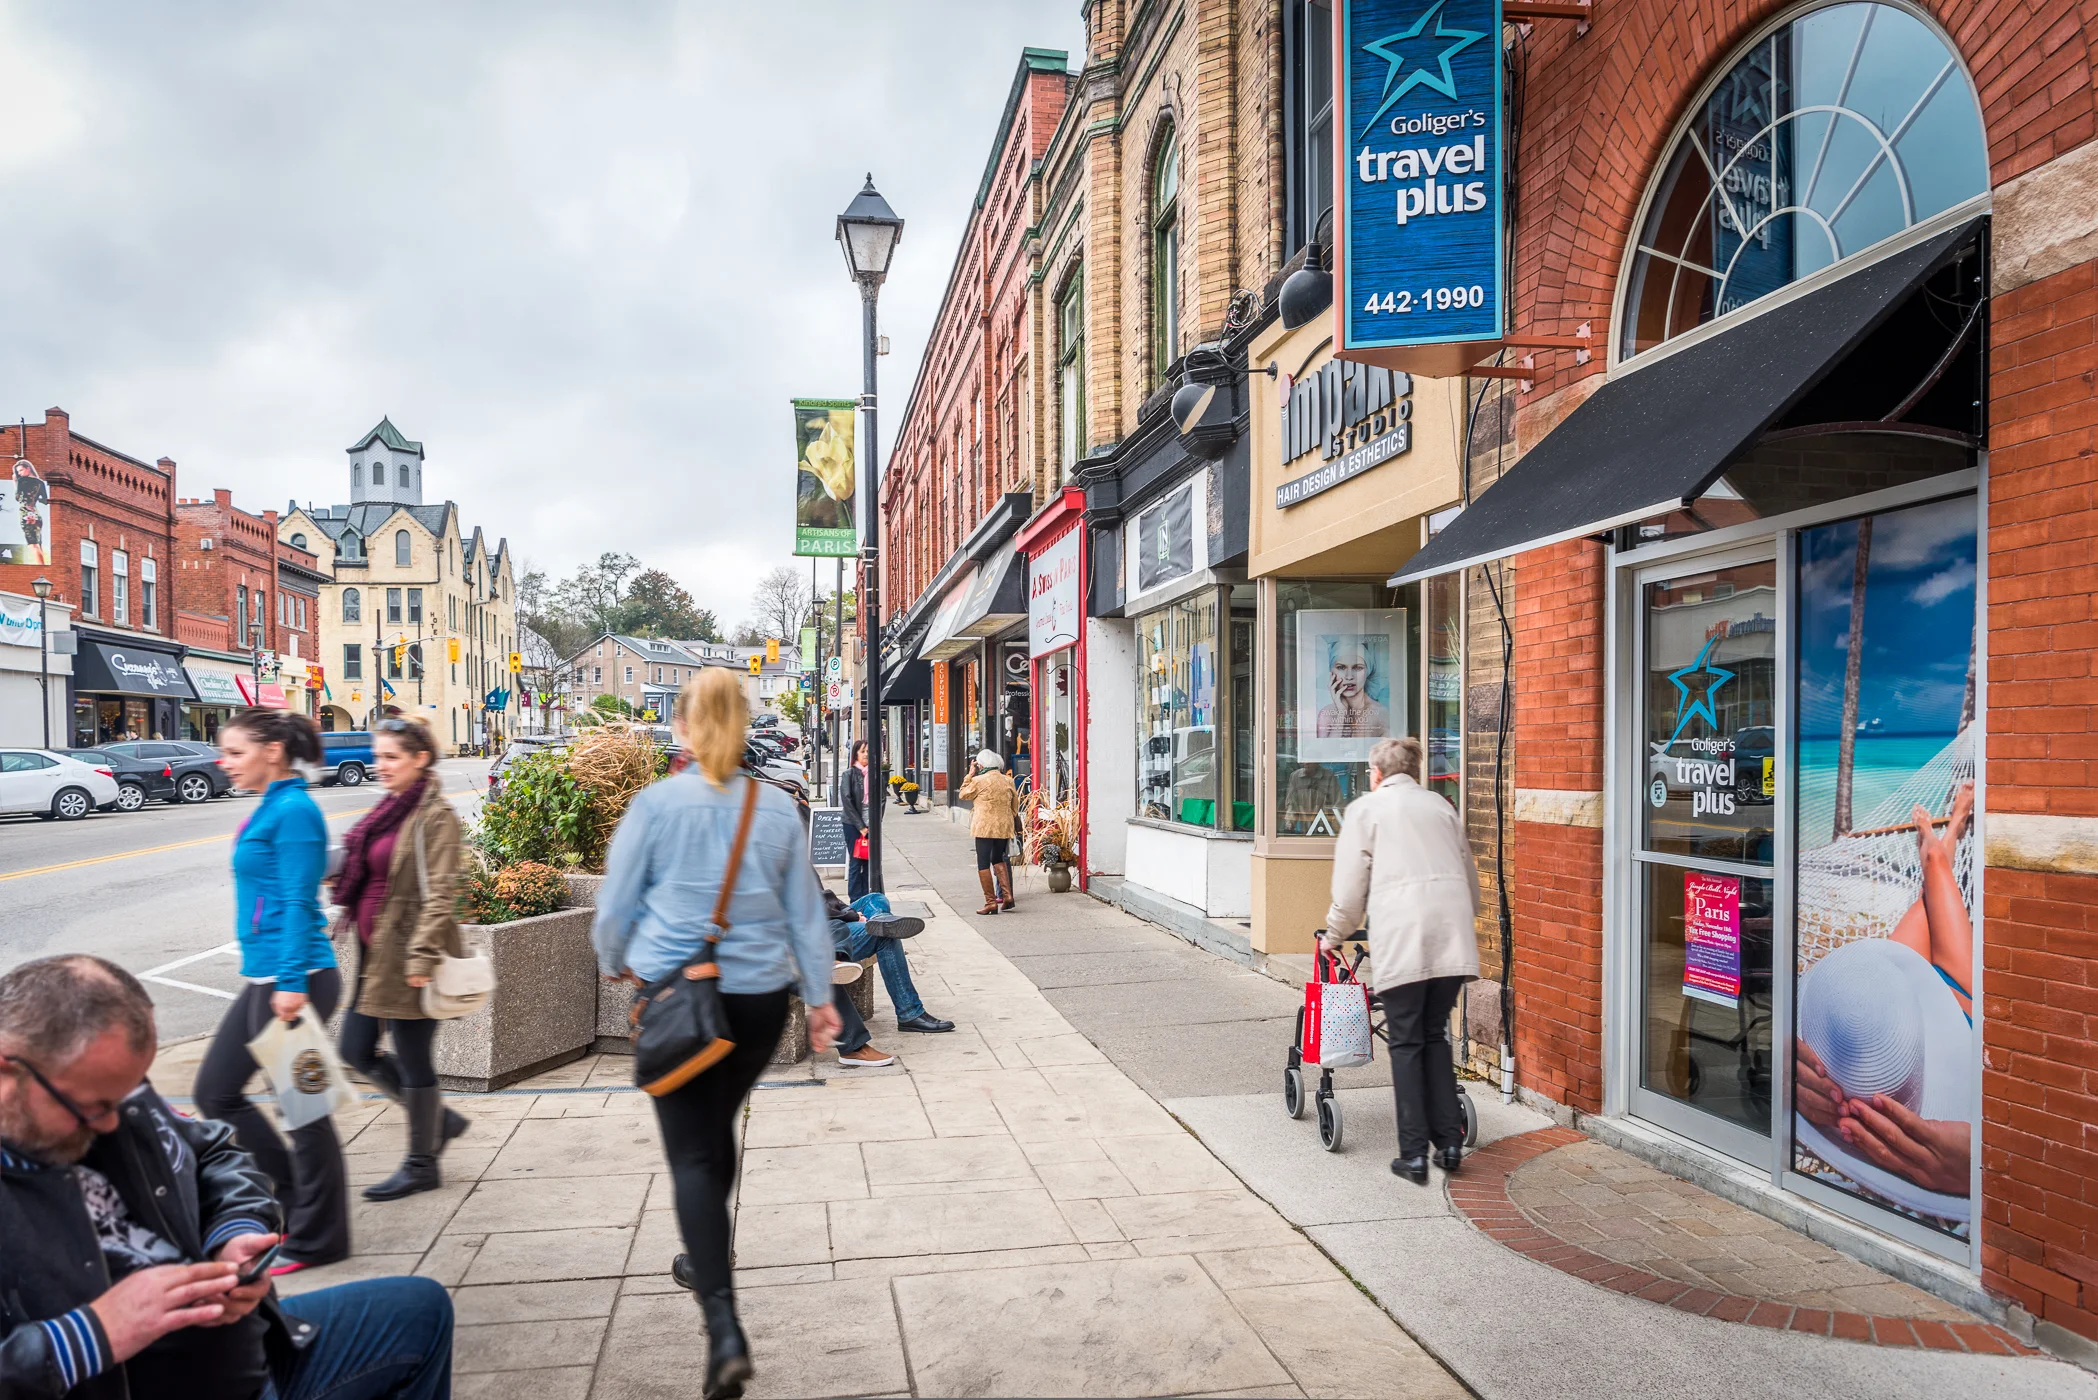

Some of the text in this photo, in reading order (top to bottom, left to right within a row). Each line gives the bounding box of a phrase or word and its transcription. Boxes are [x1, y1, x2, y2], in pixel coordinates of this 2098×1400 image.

[1391, 109, 1486, 135] Goliger's
[1356, 134, 1486, 183] travel
[1397, 178, 1487, 225] plus
[798, 398, 851, 408] Kindred Spirits
[1332, 400, 1413, 457] STUDIO
[1277, 428, 1406, 505] HAIR DESIGN & ESTHETICS
[801, 527, 852, 538] ARTISANS OF
[800, 539, 852, 553] PARIS
[1349, 708, 1361, 716] the
[1362, 708, 1380, 718] glow
[1355, 716, 1369, 725] you
[1691, 738, 1736, 755] Goliger's
[1676, 757, 1735, 786] travel
[1693, 787, 1735, 817] plus
[1695, 897, 1730, 922] Paris
[1688, 925, 1699, 934] Tax
[1698, 928, 1711, 937] Free
[1711, 931, 1737, 944] Shopping
